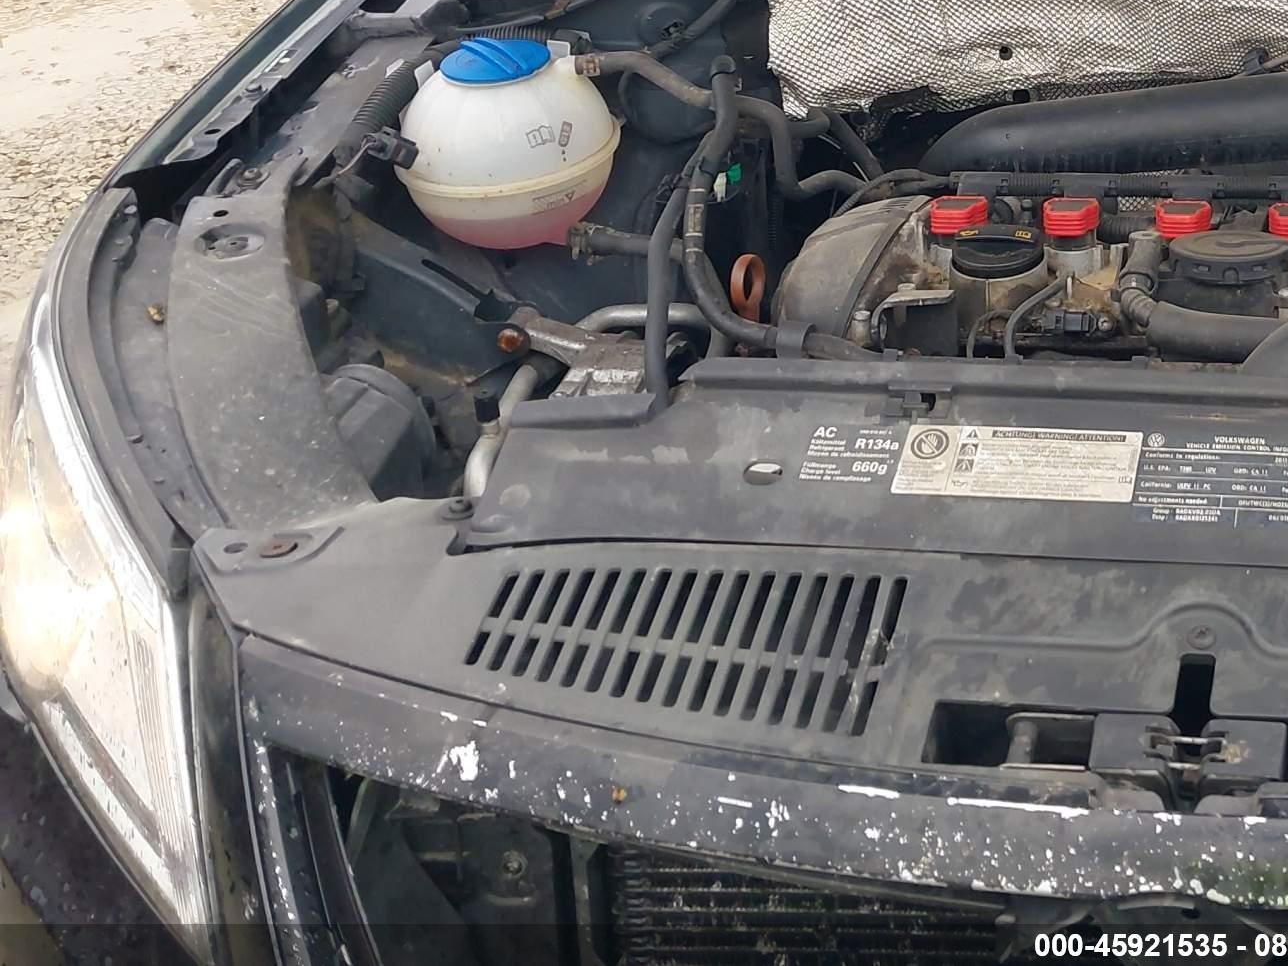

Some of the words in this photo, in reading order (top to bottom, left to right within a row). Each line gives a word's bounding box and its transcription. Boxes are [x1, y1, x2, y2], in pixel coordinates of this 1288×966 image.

[814, 426, 837, 438] AC
[1038, 432, 1077, 440] WARNING!
[854, 438, 899, 450] R134a
[1214, 436, 1265, 444] VOLKSWAGEN
[852, 461, 888, 475] 660g
